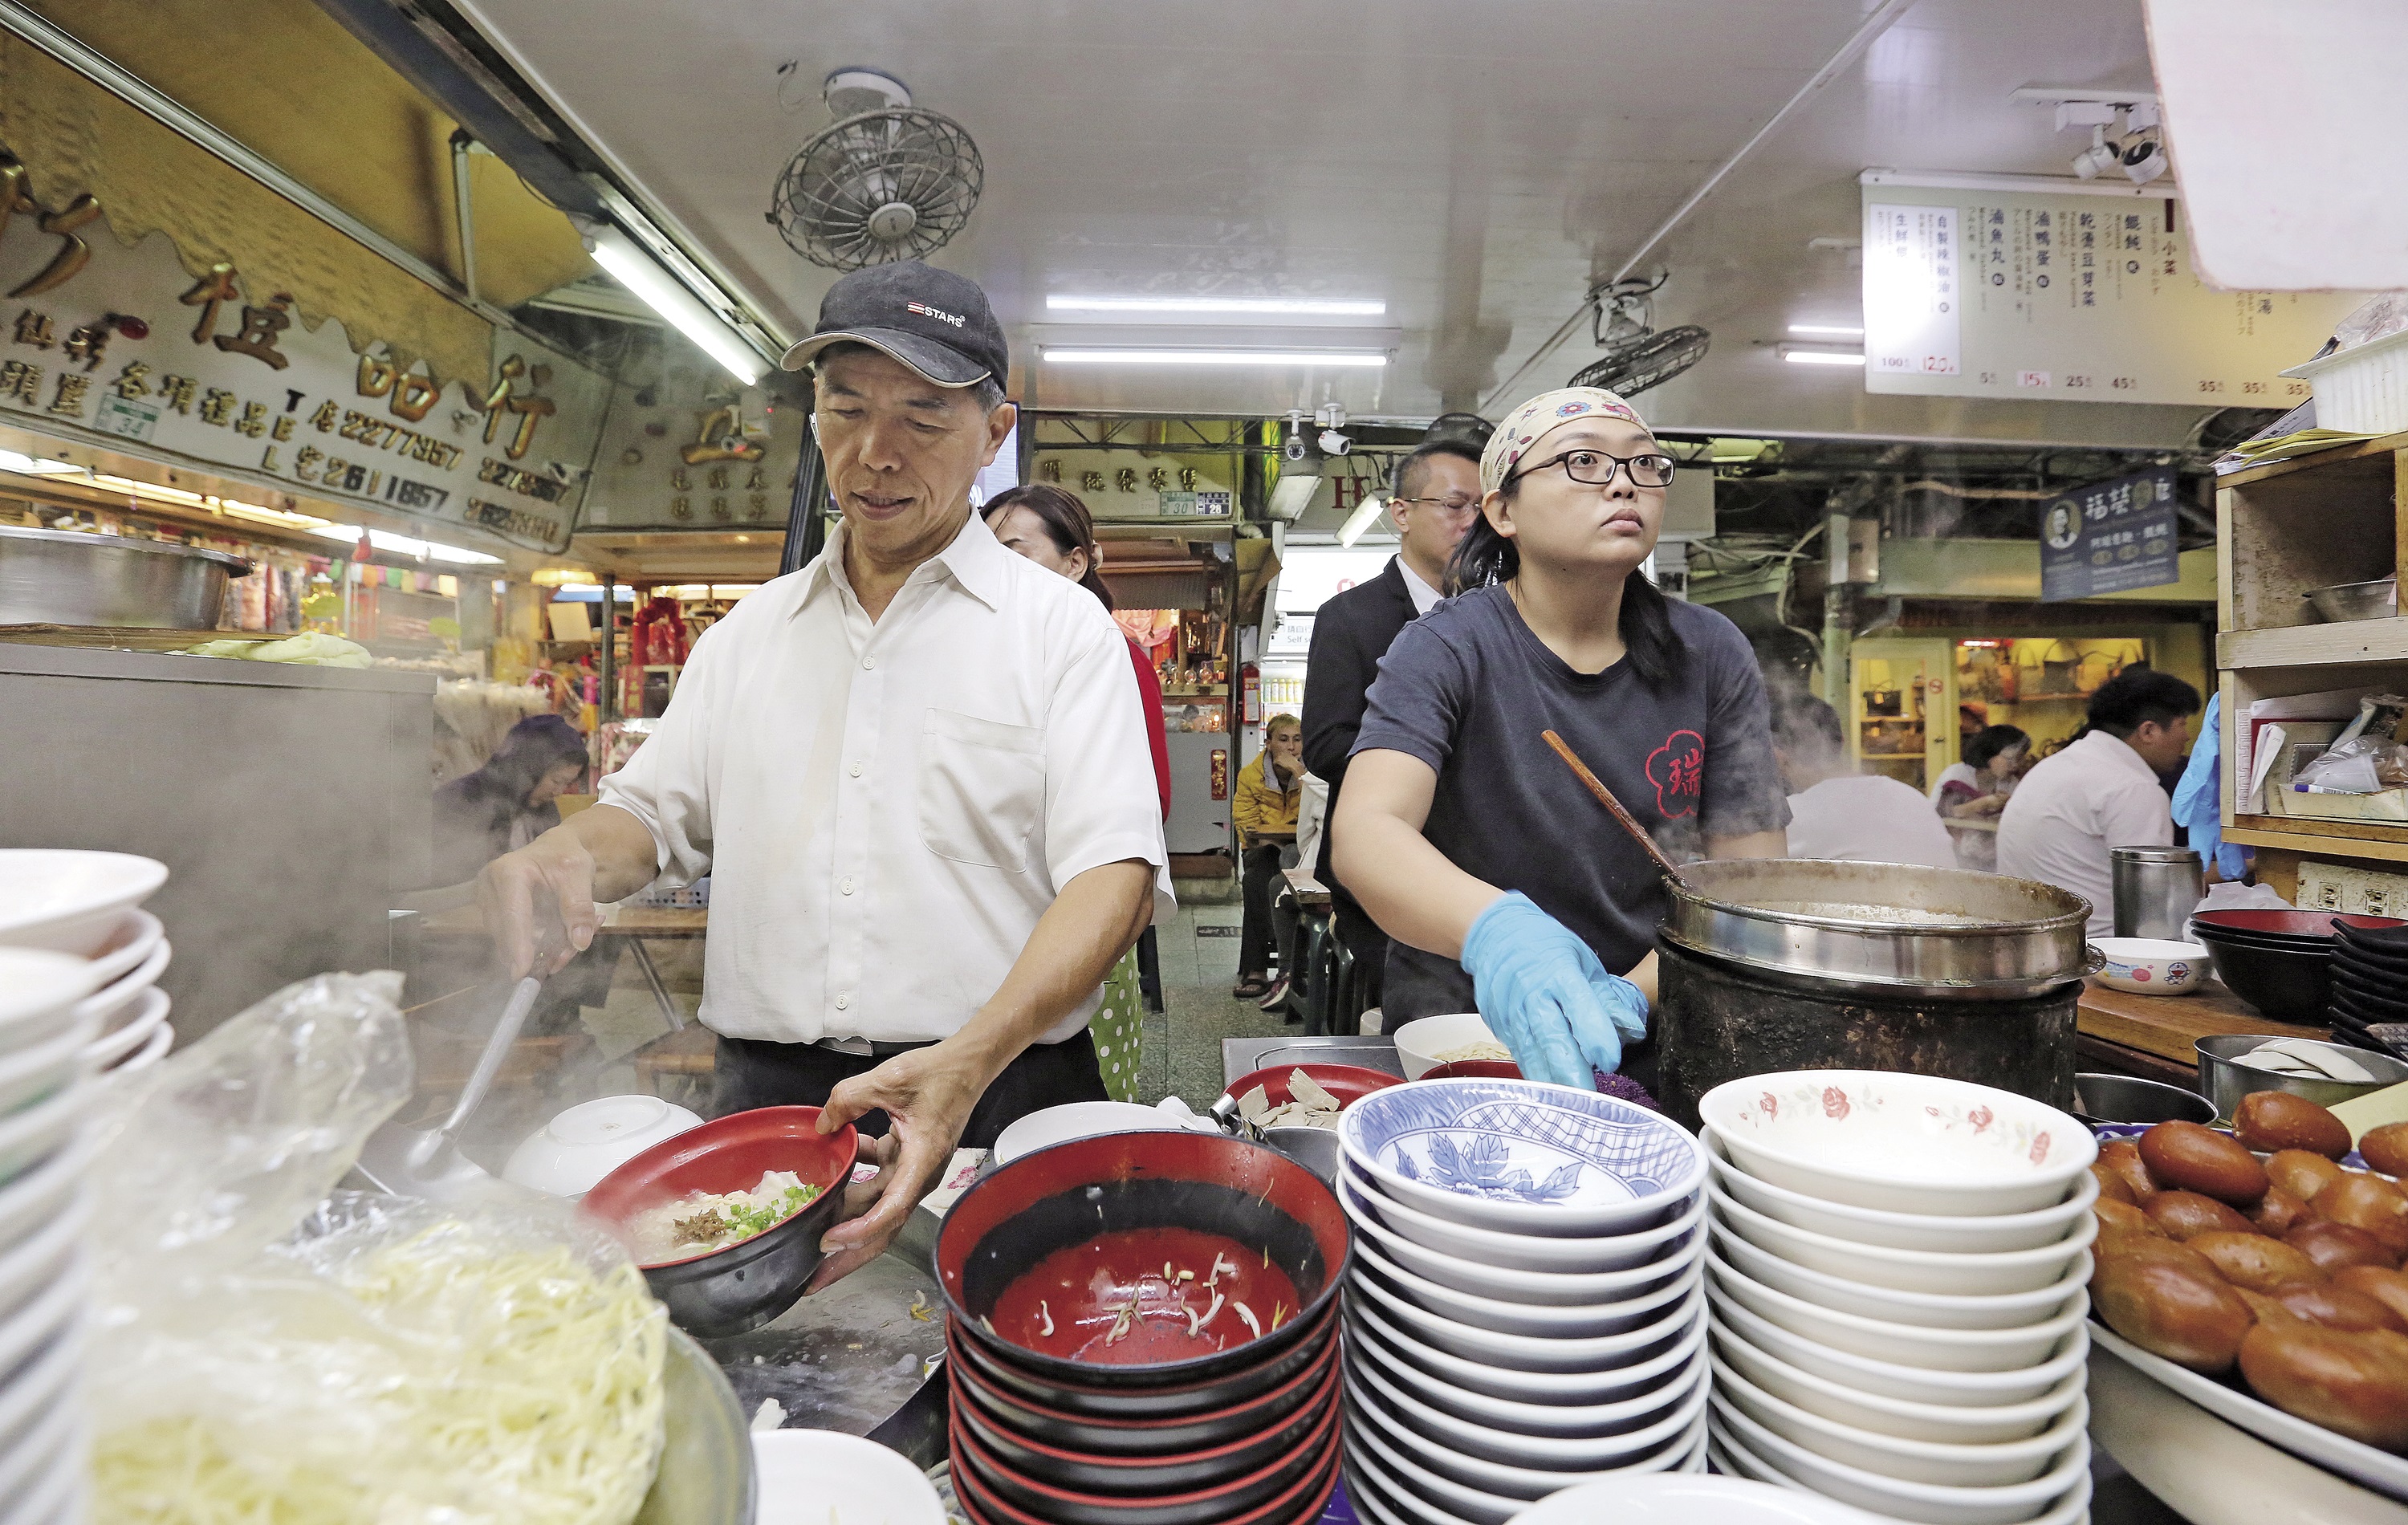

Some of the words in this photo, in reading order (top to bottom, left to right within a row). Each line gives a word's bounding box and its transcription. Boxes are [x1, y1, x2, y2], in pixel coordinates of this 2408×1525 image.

[924, 306, 962, 327] STARS
[1173, 502, 1189, 514] 30
[1209, 503, 1222, 514] 28
[1287, 635, 1302, 644] Self
